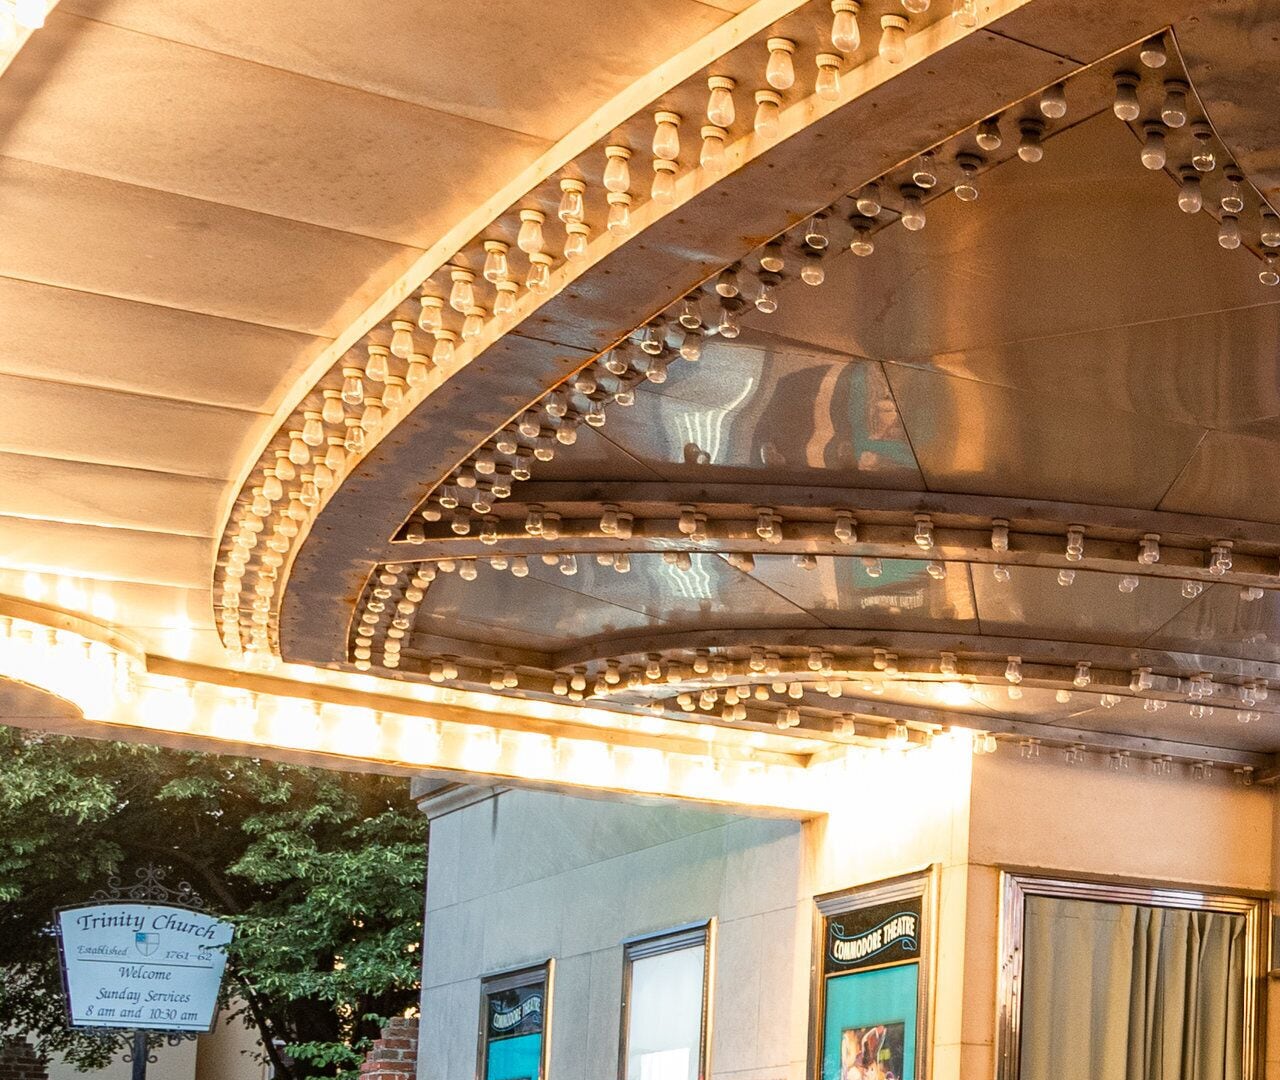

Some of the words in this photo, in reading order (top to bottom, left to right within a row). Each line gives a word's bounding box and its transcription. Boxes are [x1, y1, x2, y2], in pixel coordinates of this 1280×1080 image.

[77, 911, 145, 932] Trinity
[152, 913, 217, 939] Church
[833, 928, 882, 961] COMMODORE
[883, 915, 915, 944] THEATRE
[77, 945, 128, 956] Established
[118, 965, 172, 981] Welcome
[96, 987, 141, 1004] Sunday
[144, 990, 191, 1003] Services
[85, 1004, 94, 1017] 8
[97, 1008, 115, 1018] am
[119, 1006, 143, 1019] and
[150, 1008, 177, 1021] 10:30
[180, 1012, 198, 1021] am
